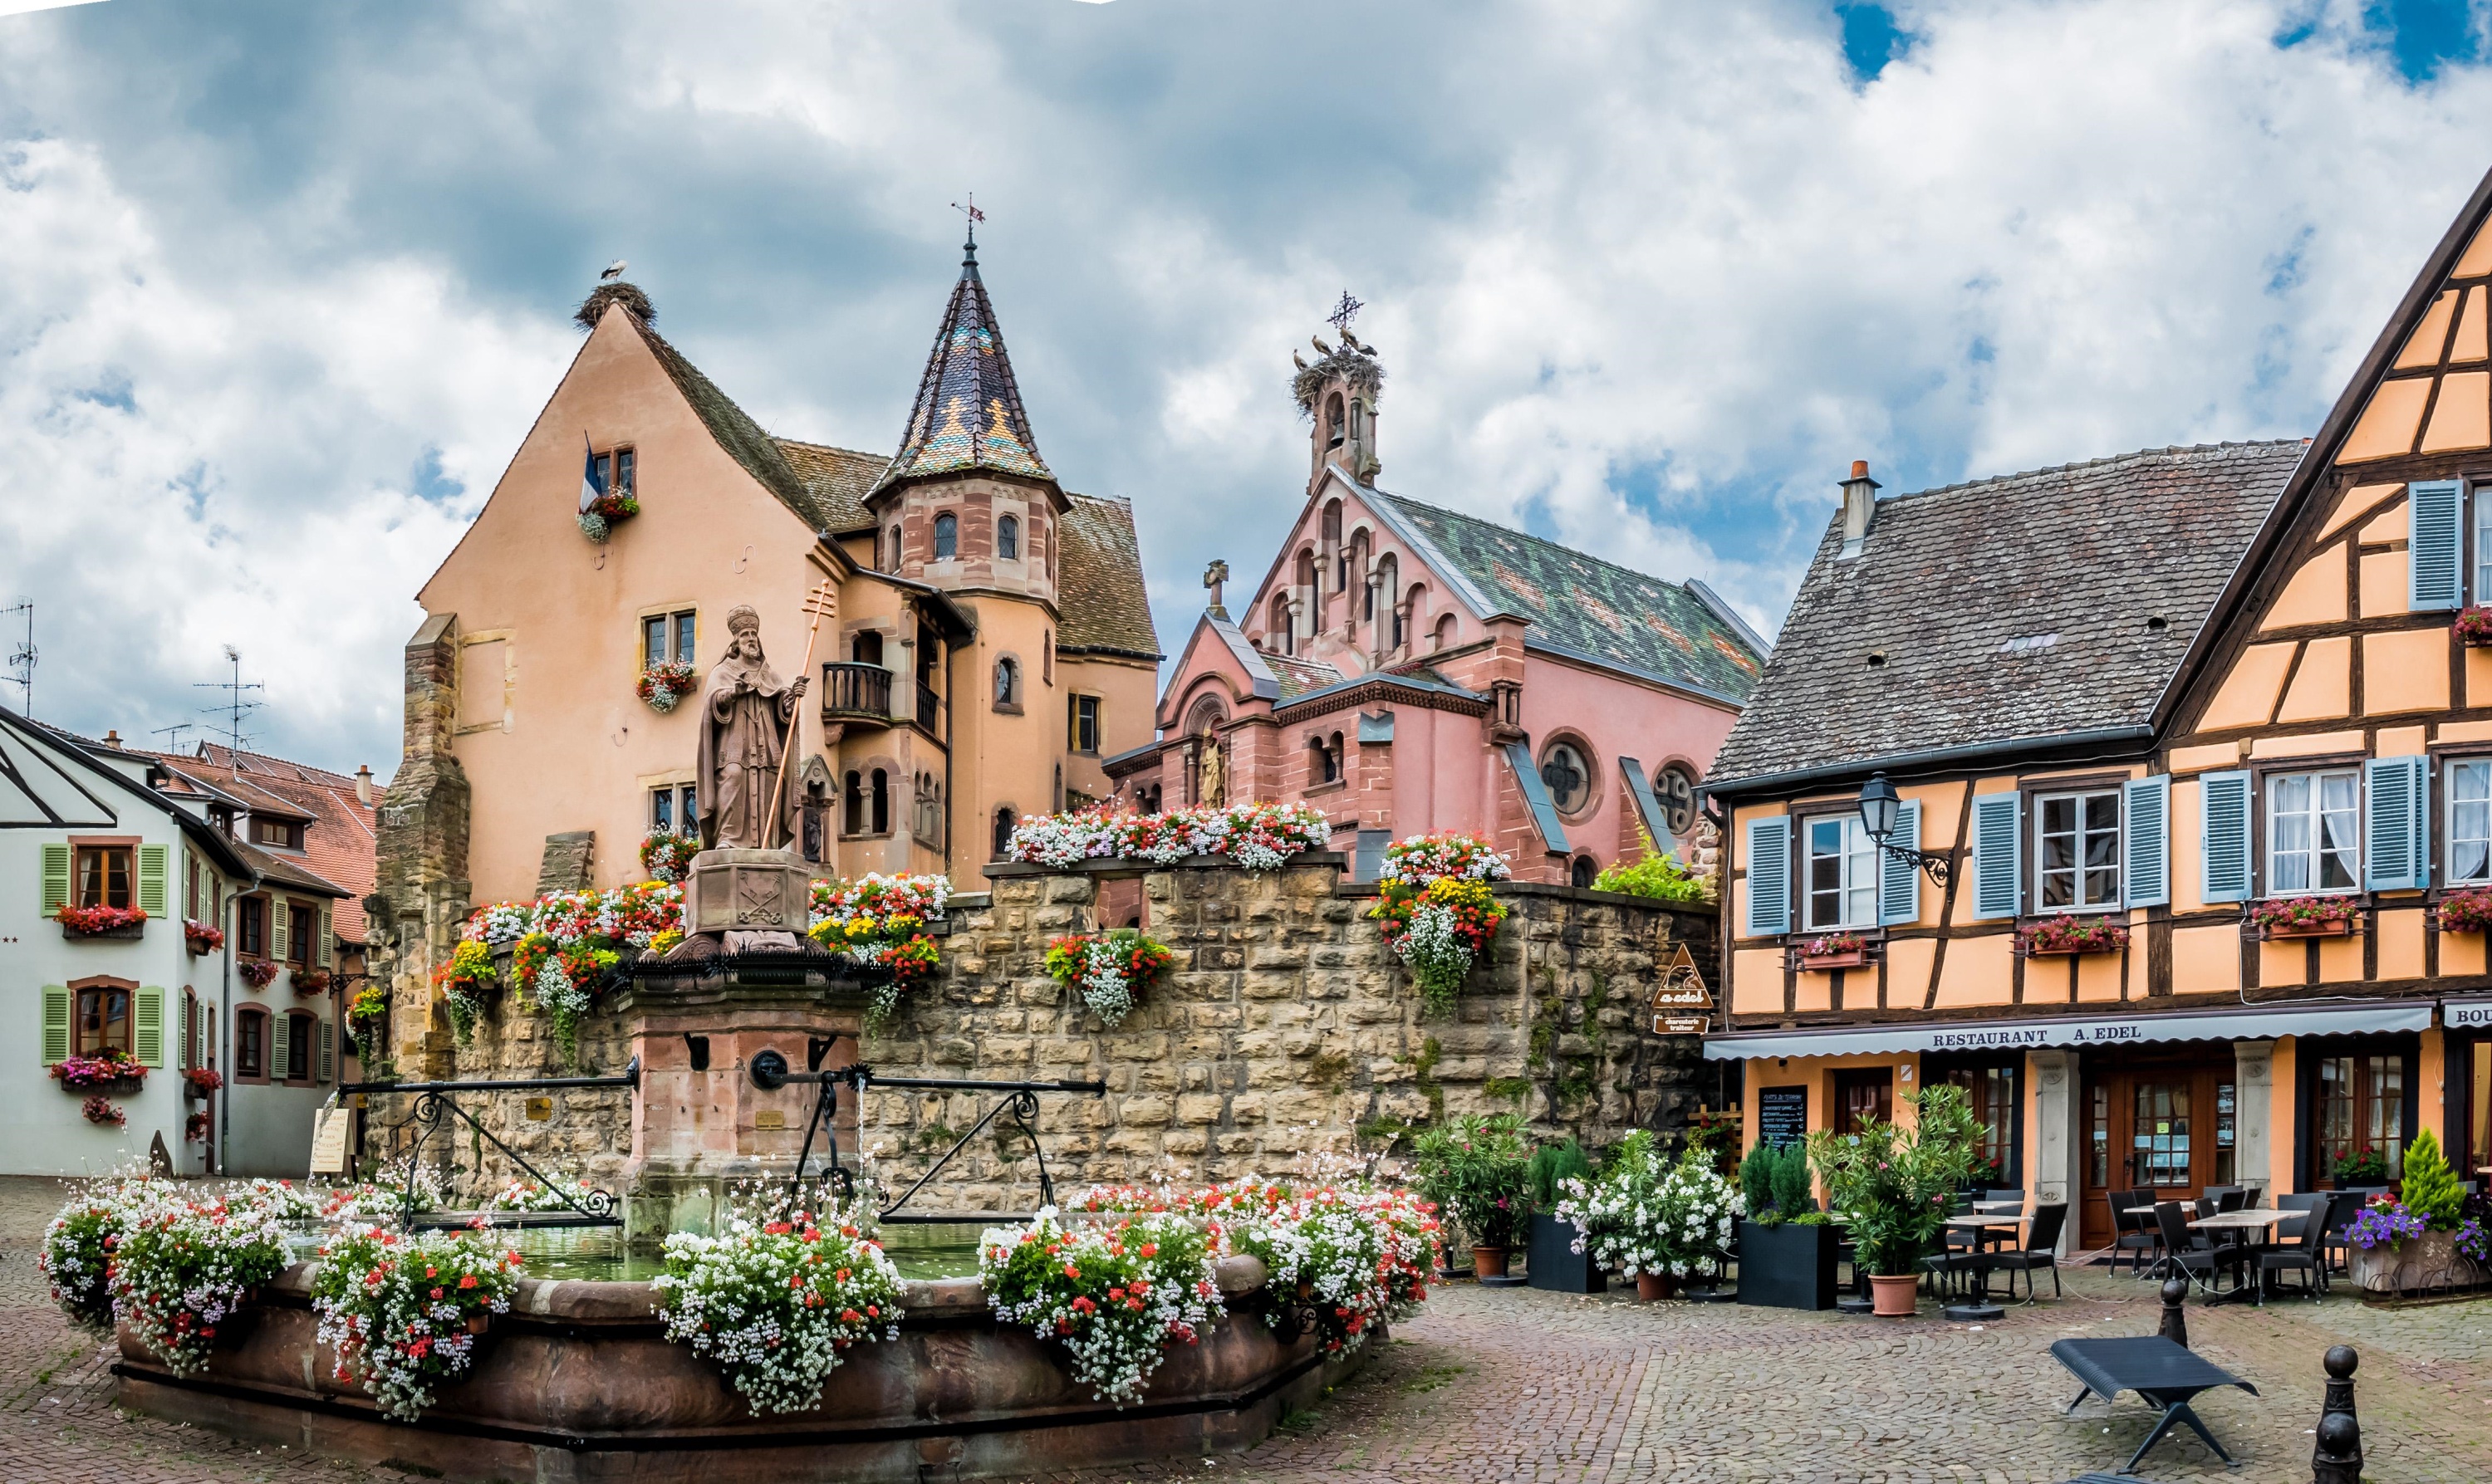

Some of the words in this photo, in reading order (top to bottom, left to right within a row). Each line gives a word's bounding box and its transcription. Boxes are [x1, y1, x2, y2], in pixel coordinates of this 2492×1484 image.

[1673, 991, 1705, 1003] edel
[1933, 1030, 2048, 1046] RESTAURANT
[2073, 1028, 2089, 1041] A.
[2094, 1026, 2141, 1040] EDEL
